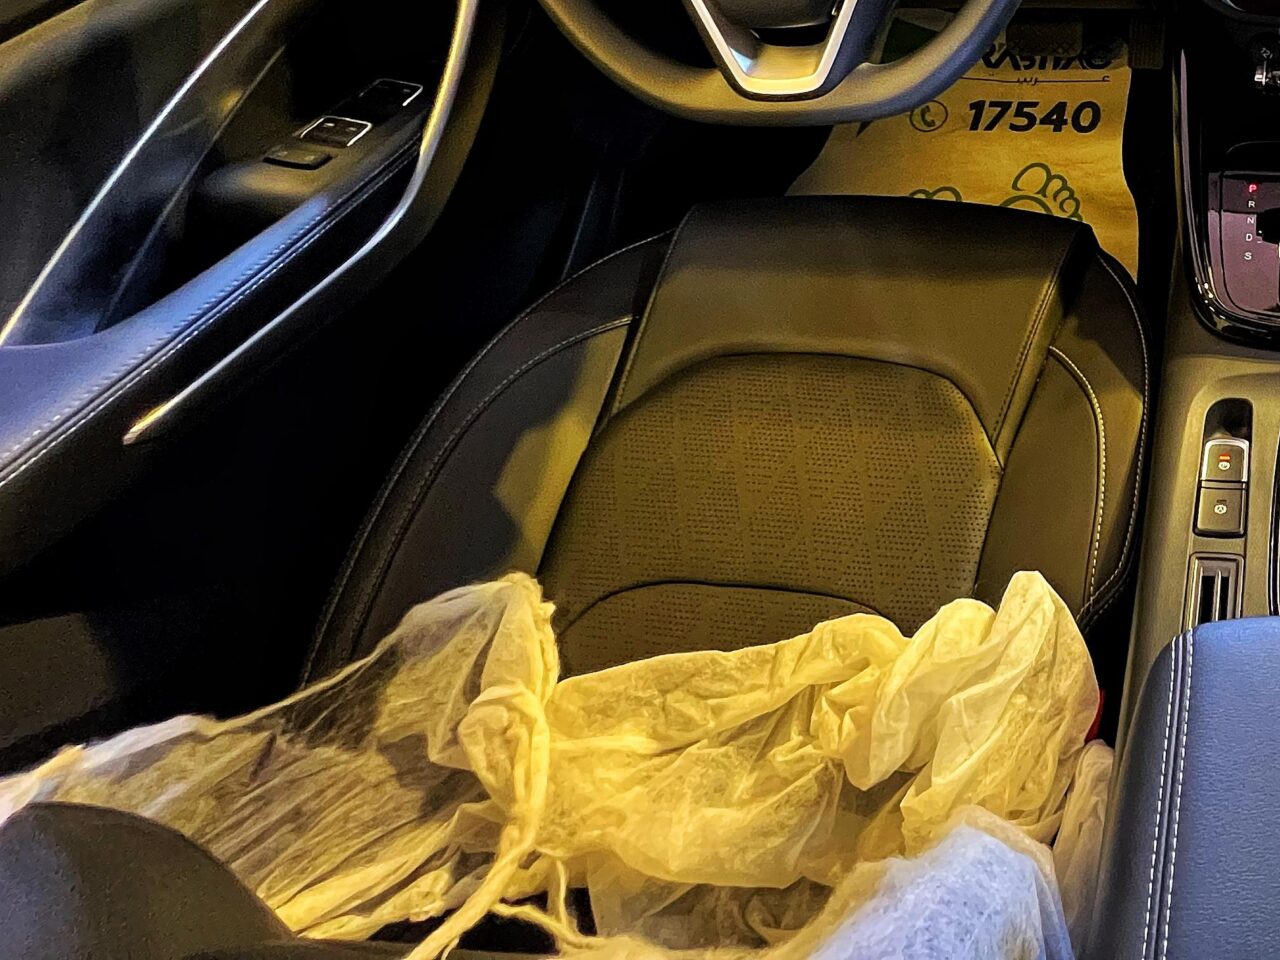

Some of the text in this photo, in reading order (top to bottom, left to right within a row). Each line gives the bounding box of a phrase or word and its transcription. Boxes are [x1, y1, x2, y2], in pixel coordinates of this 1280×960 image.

[968, 99, 1102, 134] 17540
[1248, 184, 1257, 193] P
[1248, 200, 1256, 208] R
[1245, 233, 1253, 242] D
[1243, 251, 1252, 260] S
